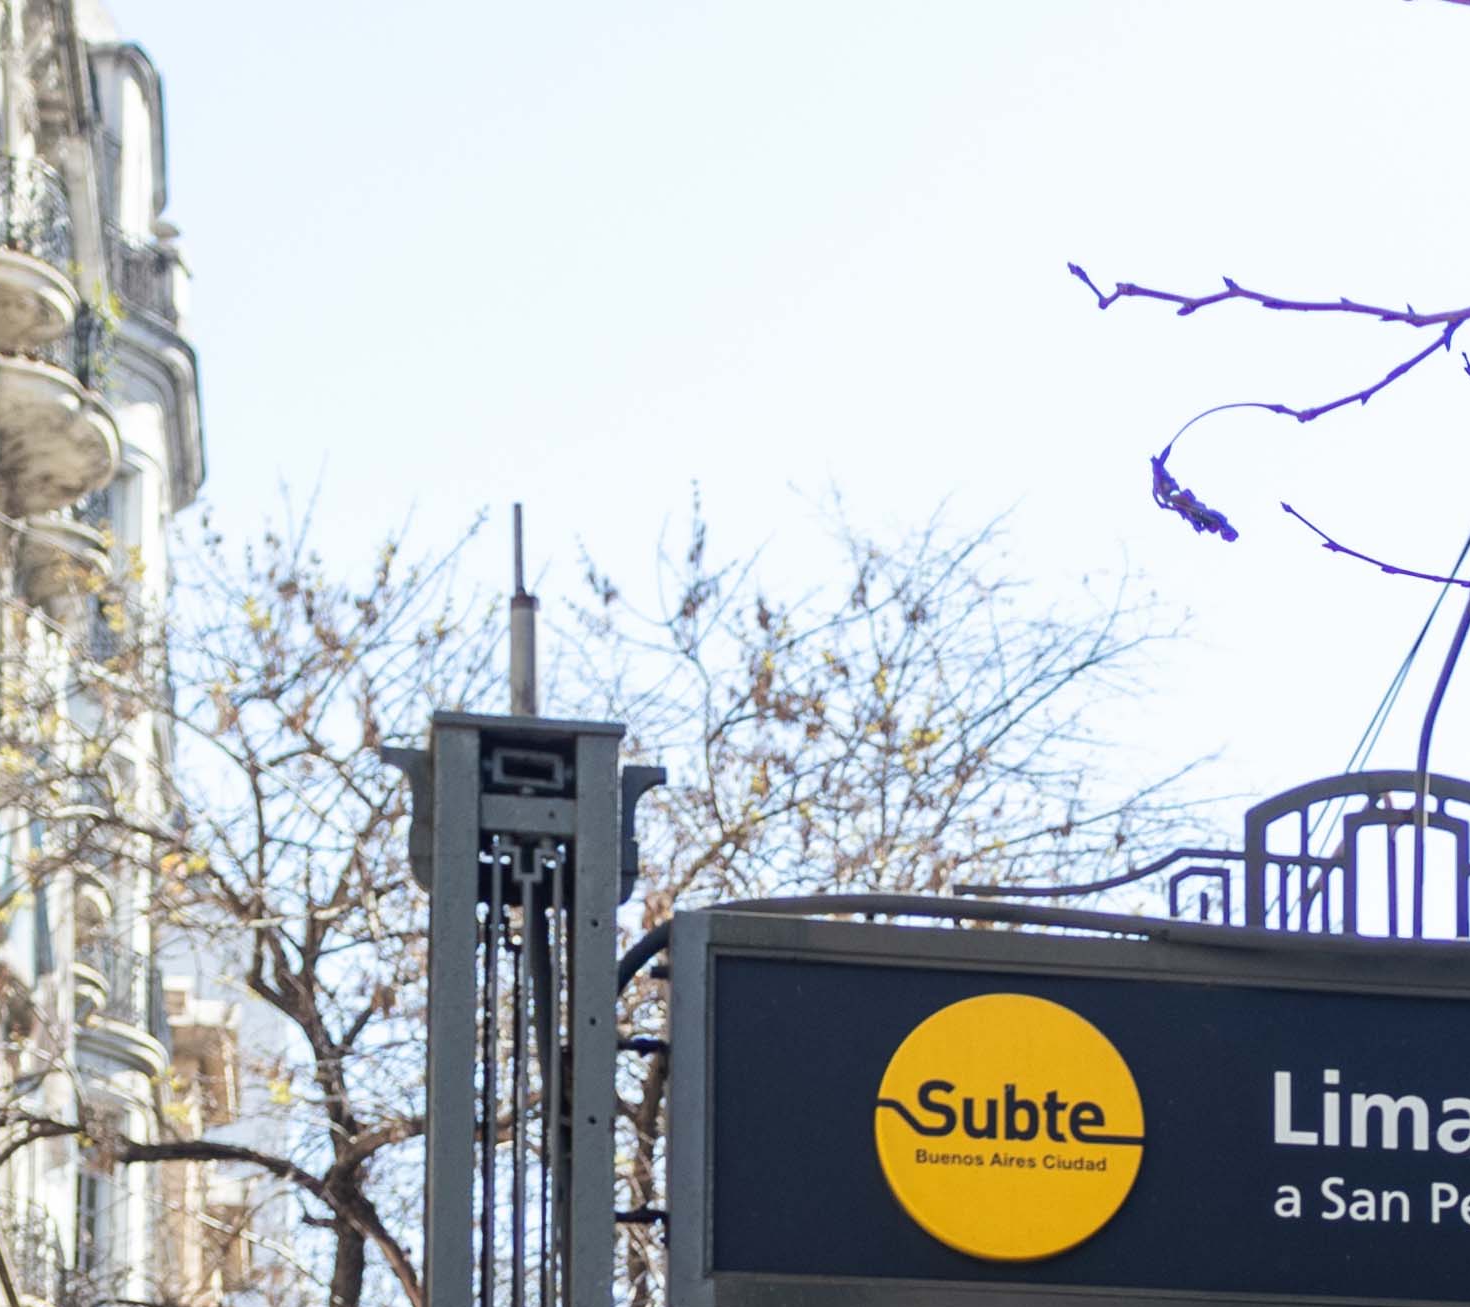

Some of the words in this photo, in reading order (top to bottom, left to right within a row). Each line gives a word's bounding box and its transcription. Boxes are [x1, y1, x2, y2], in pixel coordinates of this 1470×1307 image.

[917, 1079, 1105, 1143] Subte
[915, 1149, 984, 1166] Buenos
[990, 1152, 1036, 1168] Aires
[1042, 1155, 1107, 1172] Ciudad
[1272, 1183, 1305, 1218] a
[1320, 1177, 1410, 1223] San
